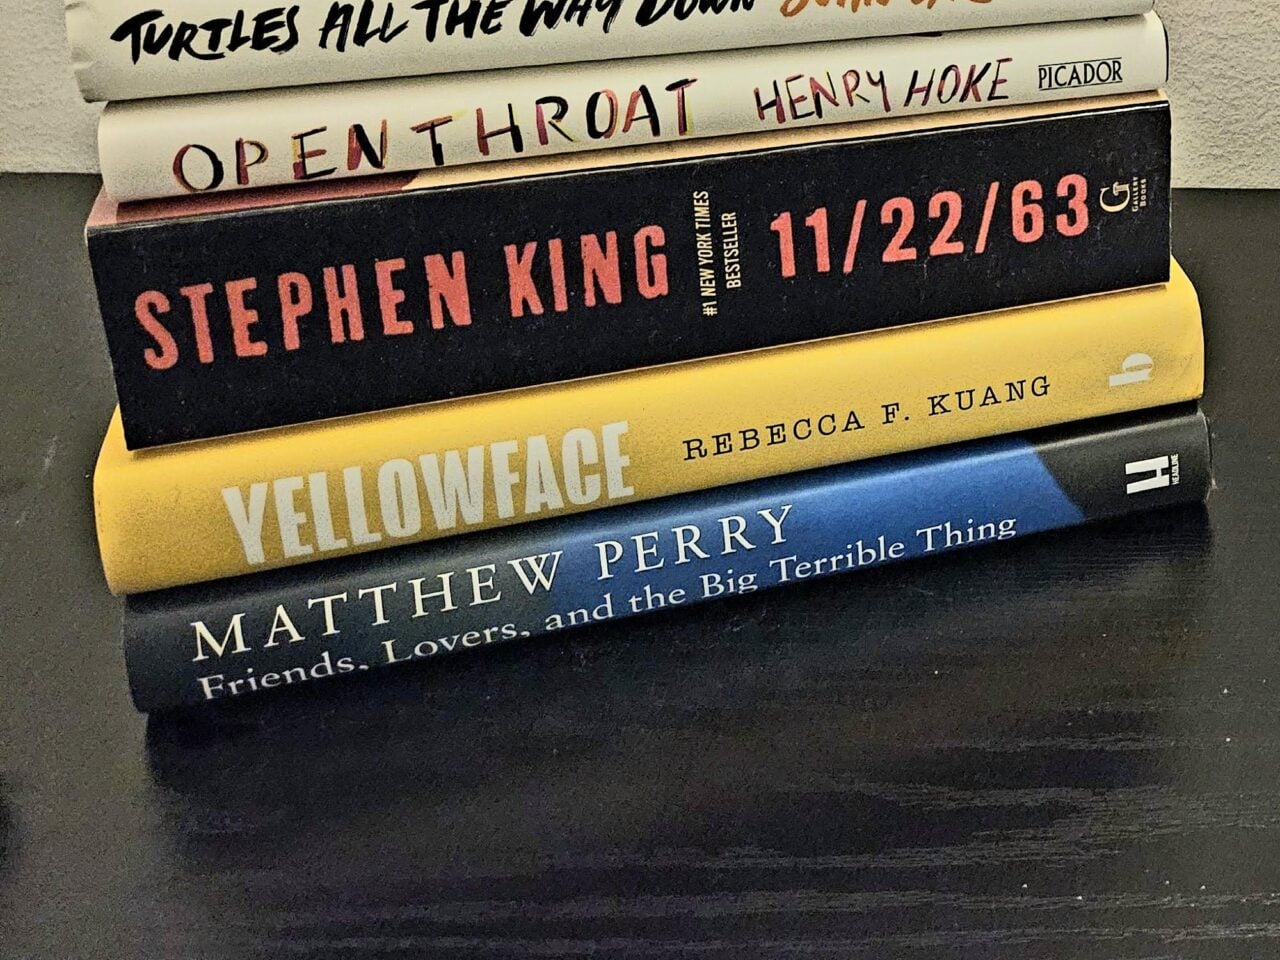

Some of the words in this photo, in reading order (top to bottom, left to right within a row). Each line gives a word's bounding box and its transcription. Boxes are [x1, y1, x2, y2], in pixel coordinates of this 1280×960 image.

[110, 4, 300, 65] TURTLES
[754, 68, 891, 124] HENRY
[903, 56, 1013, 108] HOKE
[1037, 59, 1123, 89] PICADOR
[172, 118, 389, 193] OPEN
[410, 78, 699, 167] THROAT
[693, 190, 711, 229] TIMES
[770, 173, 1089, 278] 11/22/63
[696, 232, 713, 266] YORK
[699, 268, 716, 297] NEW
[721, 211, 741, 289] BESTSELLER
[134, 250, 472, 370] STEPHEN
[503, 224, 669, 318] KING
[702, 300, 718, 316] #1
[682, 410, 865, 461] REBECCA
[880, 402, 911, 425] F.
[927, 375, 1052, 418] KUANG
[221, 421, 634, 566] YELLOWFACE
[190, 550, 563, 662] MATTHEW
[597, 504, 794, 582] PERRY
[382, 618, 530, 664] Lovers,
[545, 593, 614, 630] and
[629, 585, 685, 611] the
[700, 570, 757, 597] Big
[769, 537, 905, 583] Terrible
[917, 517, 1017, 552] Thing
